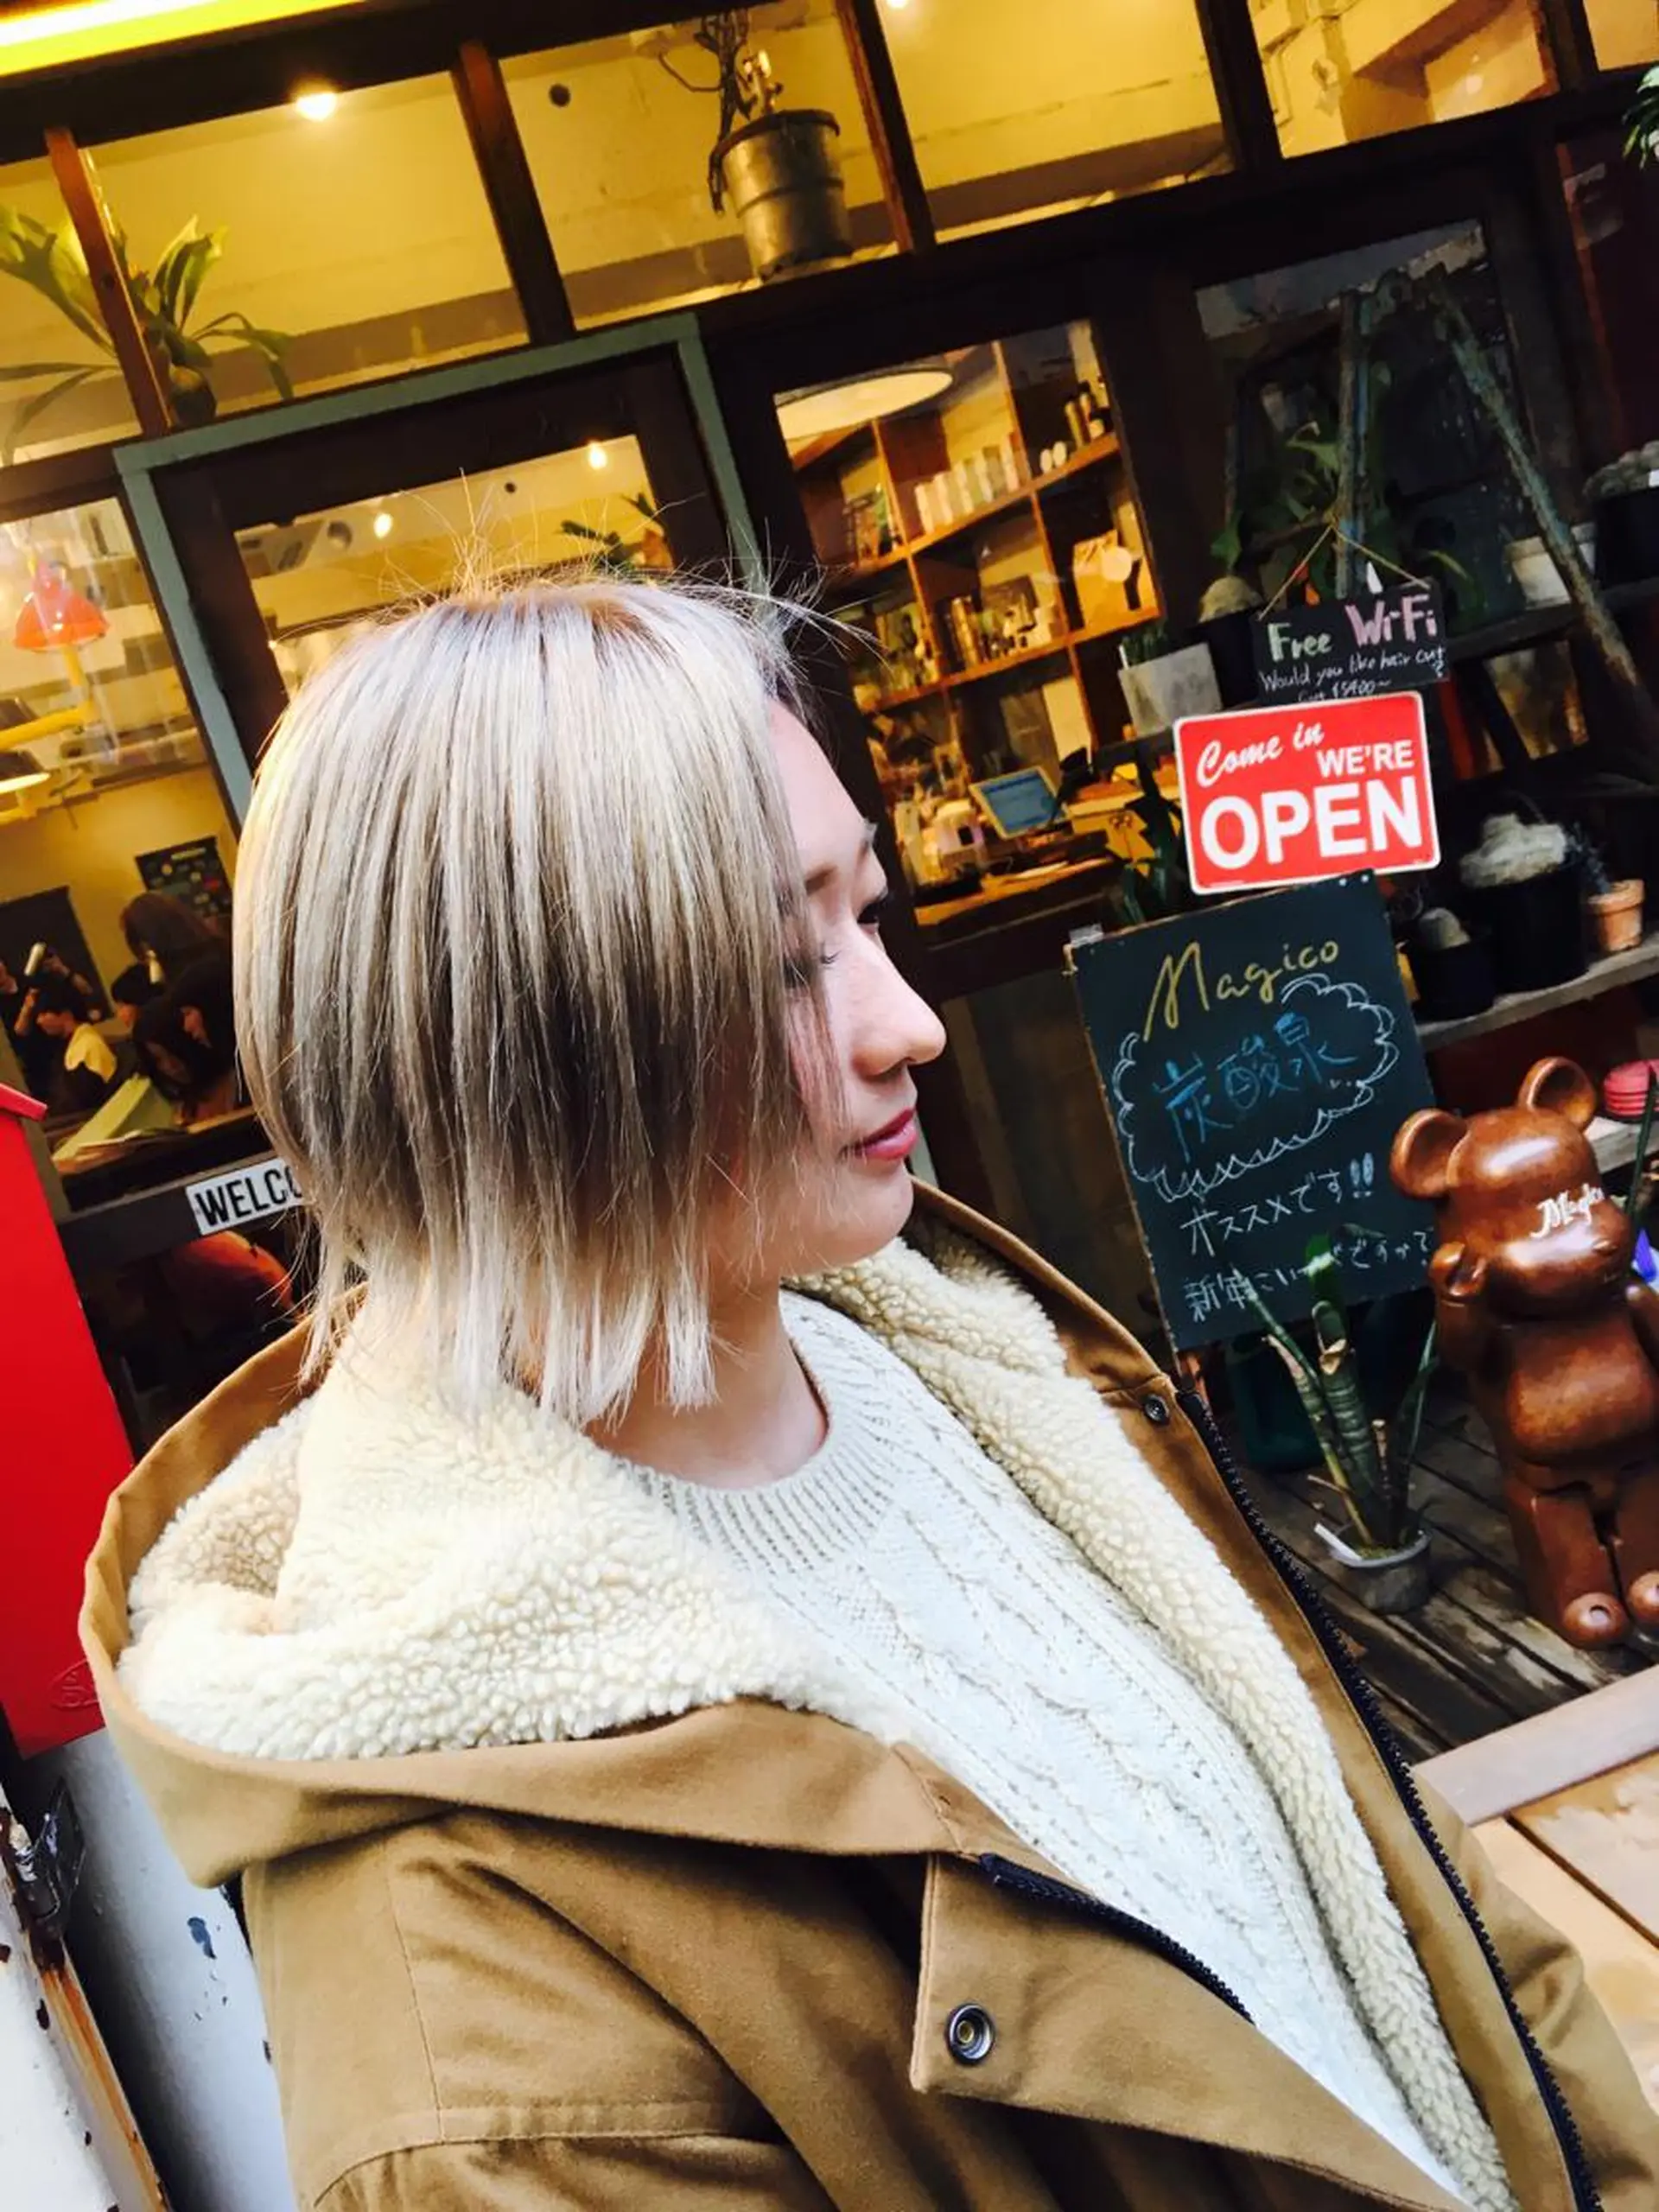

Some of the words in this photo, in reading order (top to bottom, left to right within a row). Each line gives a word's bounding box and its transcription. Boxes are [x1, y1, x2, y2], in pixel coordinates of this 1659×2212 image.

[1267, 621, 1332, 663] Free
[1344, 594, 1438, 647] Wi-Fi
[1258, 663, 1311, 692] Would
[1316, 665, 1343, 687] you
[1349, 651, 1376, 675] like
[1379, 648, 1411, 669] hair
[1196, 734, 1283, 788] Come
[1292, 721, 1325, 751] in
[1317, 739, 1415, 778] WE'RE
[1199, 775, 1423, 870] OPEN
[1143, 940, 1339, 1043] Magico
[1152, 1011, 1358, 1164] 炭酸泉
